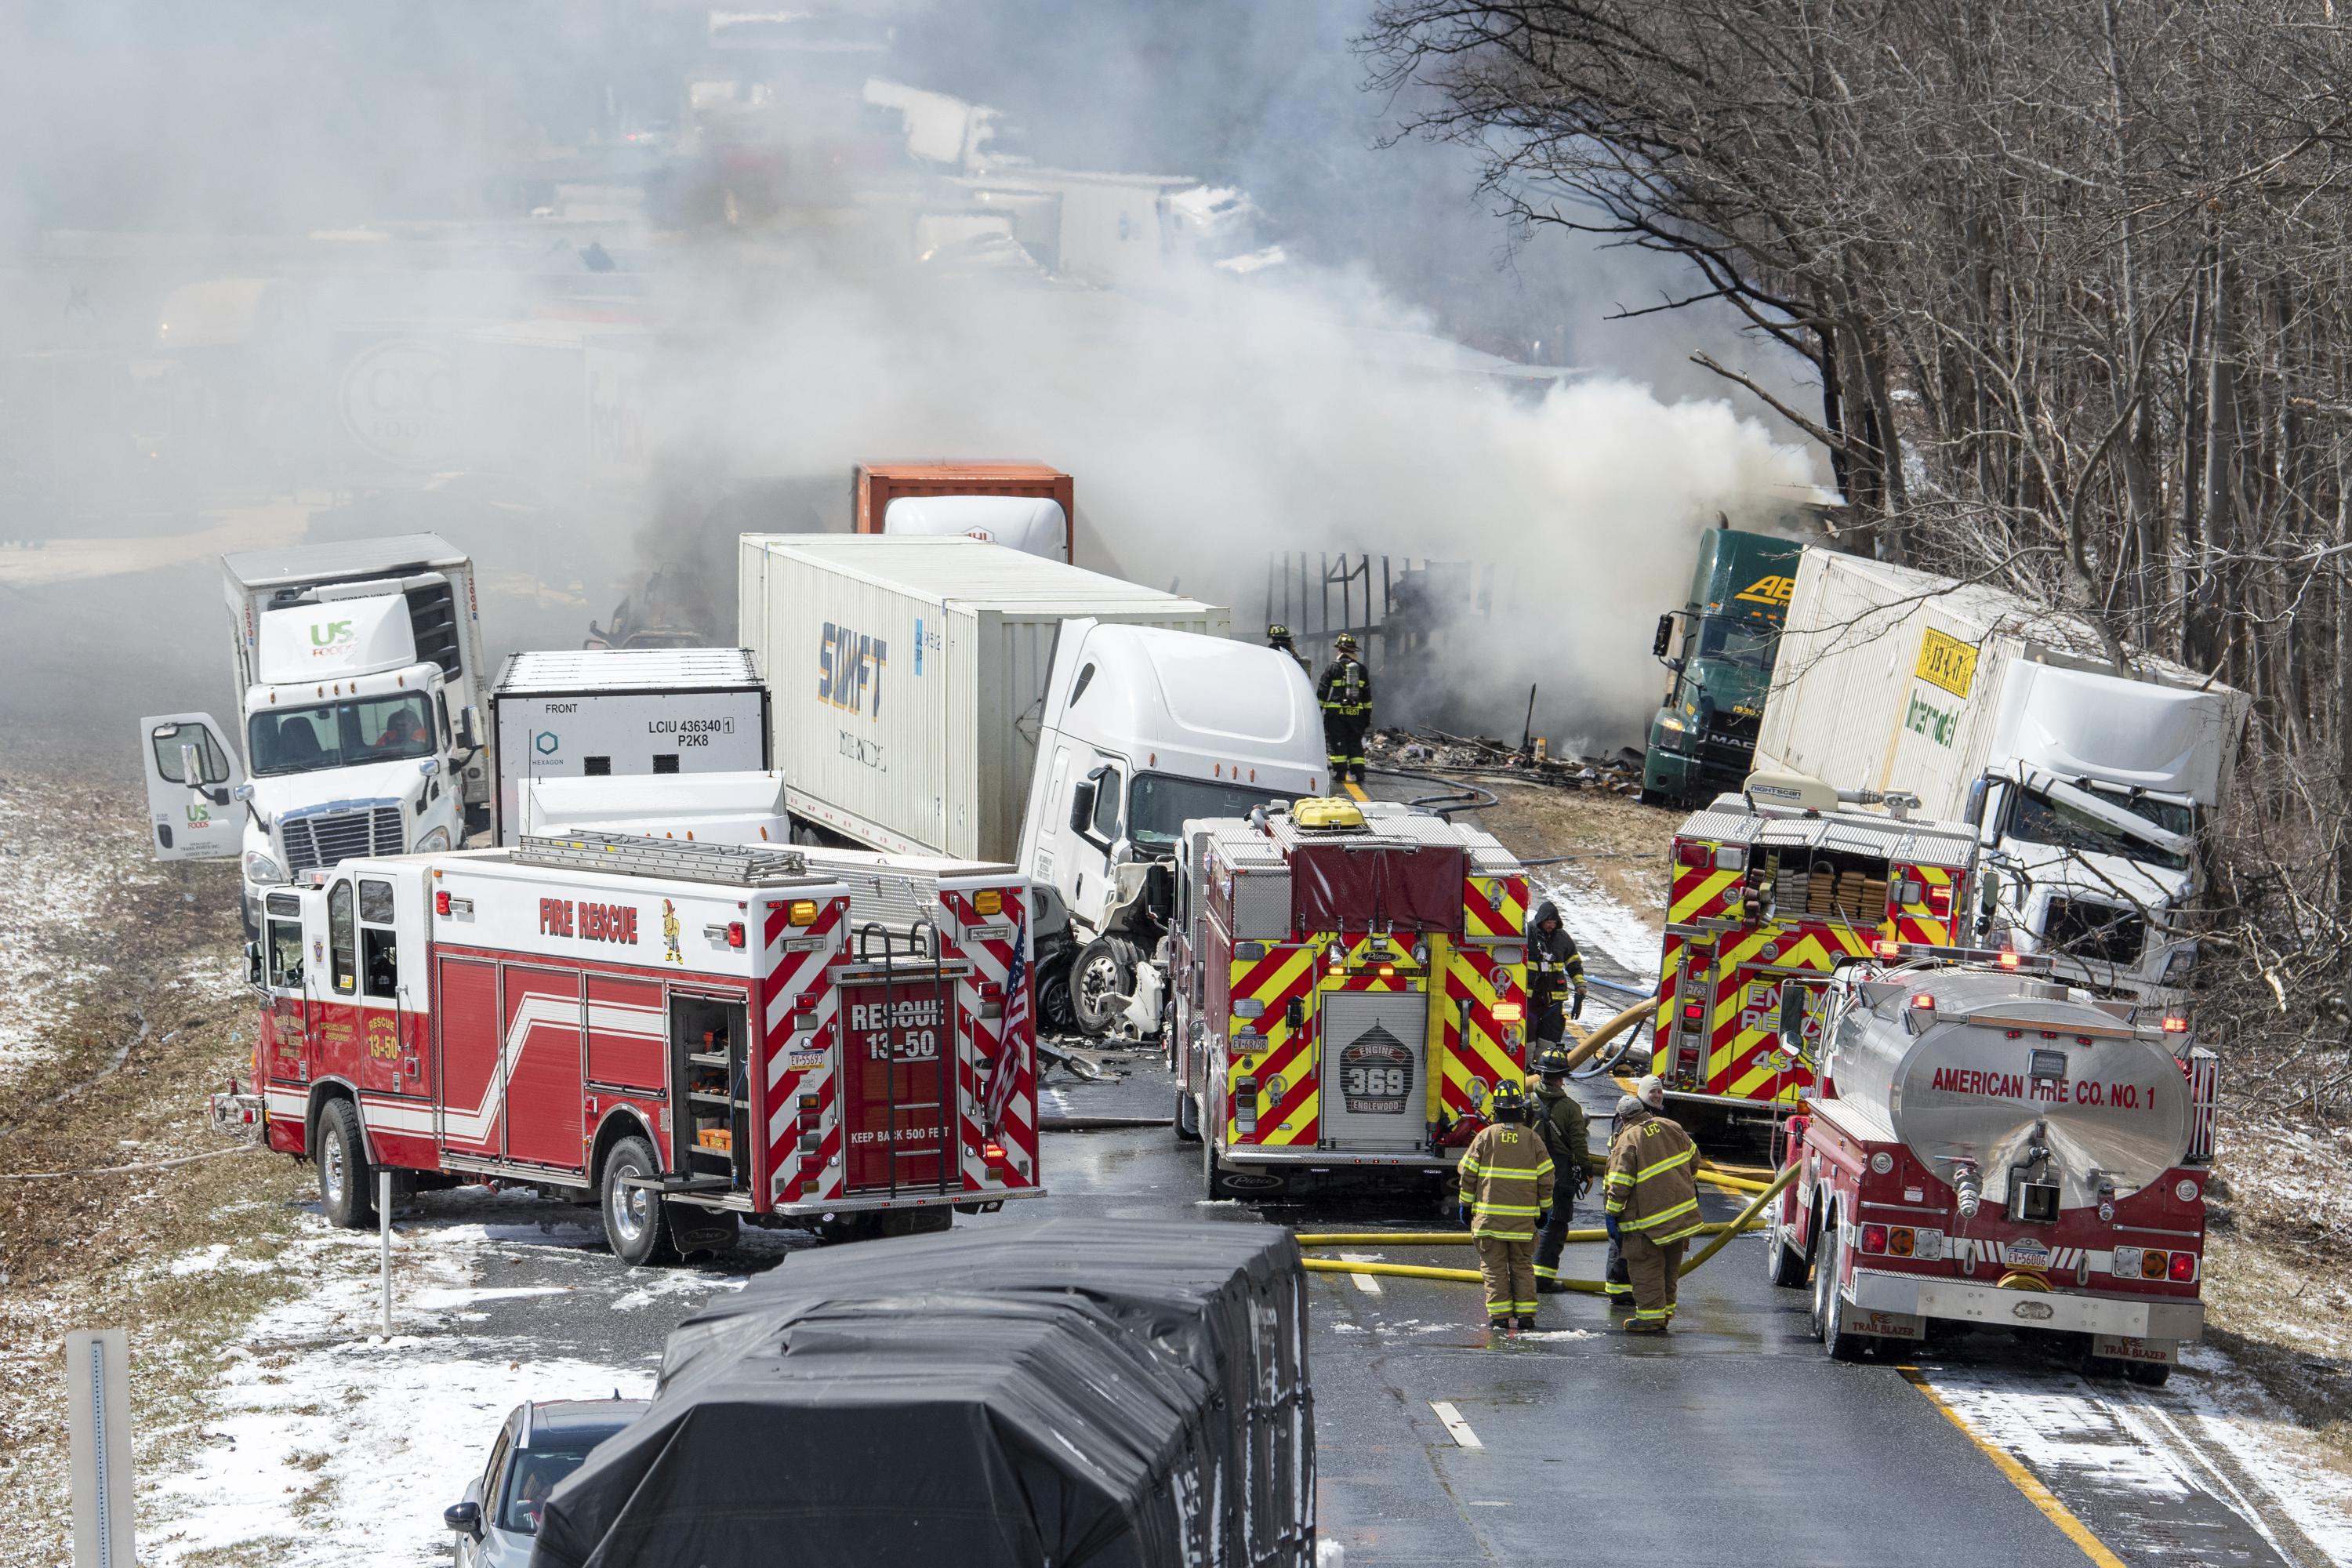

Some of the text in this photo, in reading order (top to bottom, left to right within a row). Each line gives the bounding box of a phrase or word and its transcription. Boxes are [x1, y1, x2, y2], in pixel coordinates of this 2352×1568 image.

[1744, 575, 1795, 600] AB
[545, 703, 578, 713] FRONT
[648, 720, 677, 733] LCIU
[680, 719, 721, 732] 436340
[677, 735, 709, 747] P2K8
[1711, 735, 1756, 750] MAC
[187, 821, 209, 829] FOODS
[539, 898, 638, 946] FIRE RESCUE
[1367, 952, 1392, 962] Pierce
[851, 1000, 945, 1031] RESCUE
[368, 1017, 395, 1031] RESCUE
[368, 1034, 398, 1060] 13-50
[866, 1030, 935, 1059] 13-50
[1359, 1046, 1394, 1057] ENGINE
[1348, 1068, 1404, 1095] 369
[1932, 1067, 2155, 1110] AMERICAN FIRE CO. NO. 1
[1353, 1101, 1399, 1110] ENGLEWOOD
[851, 1132, 874, 1144] KEEP
[906, 1128, 925, 1140] 500
[928, 1127, 949, 1138] FET
[1501, 1132, 1519, 1144] LFC
[1644, 1123, 1661, 1138] LFC
[1852, 1322, 1915, 1337] TRAIL BLAZER
[2103, 1345, 2167, 1361] TRAIL BLAZER
